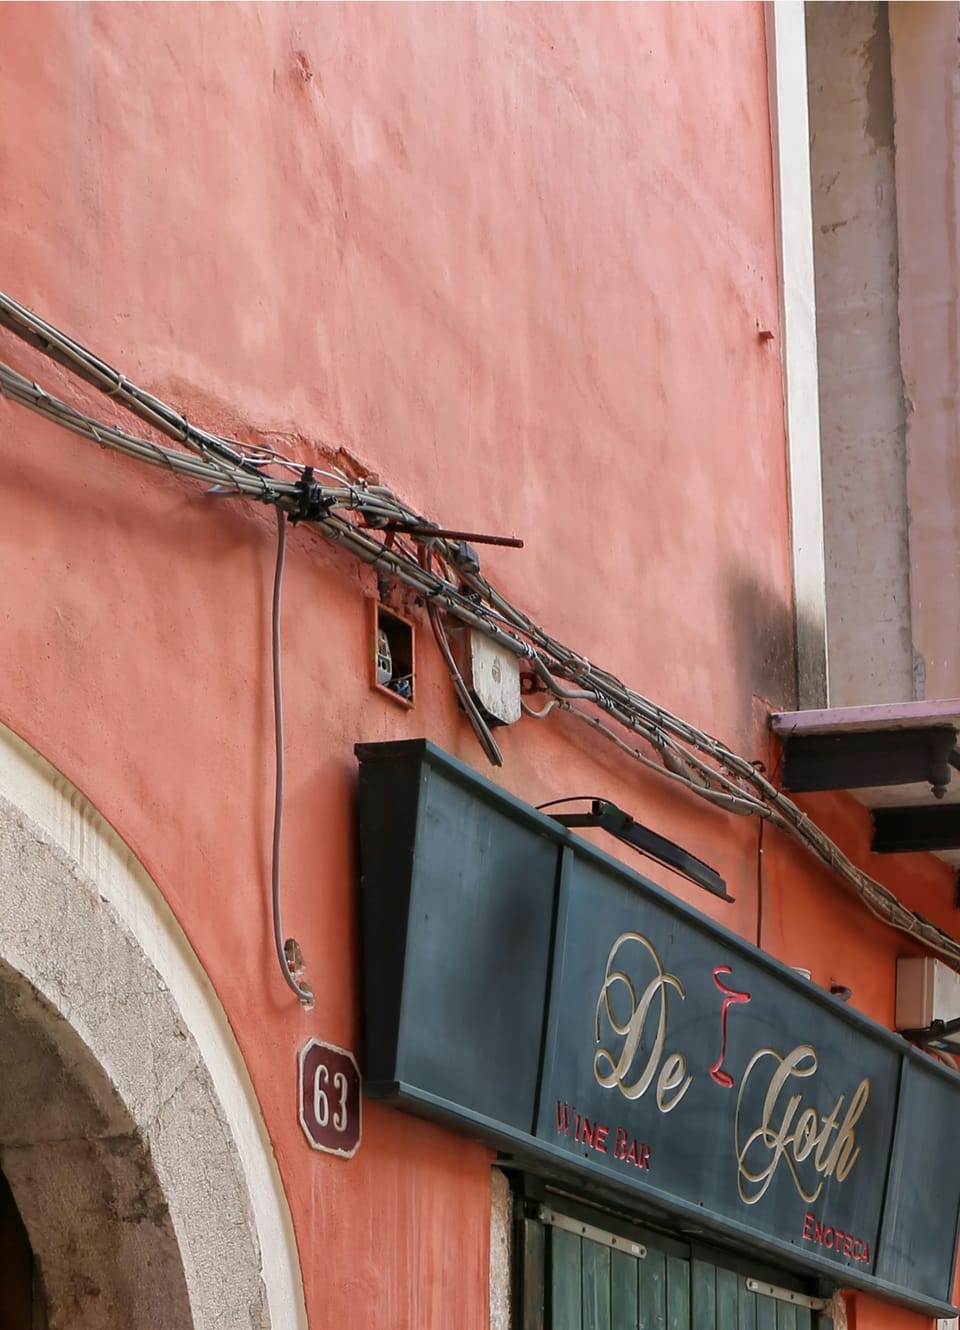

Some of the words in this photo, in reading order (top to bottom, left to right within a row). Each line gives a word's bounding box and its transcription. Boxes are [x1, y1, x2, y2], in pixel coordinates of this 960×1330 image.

[313, 1064, 348, 1132] 63
[594, 931, 693, 1113] De
[735, 1045, 870, 1204] Goth
[554, 1100, 609, 1153] WINE
[613, 1127, 651, 1171] BAR
[802, 1212, 870, 1264] ENOTECA
